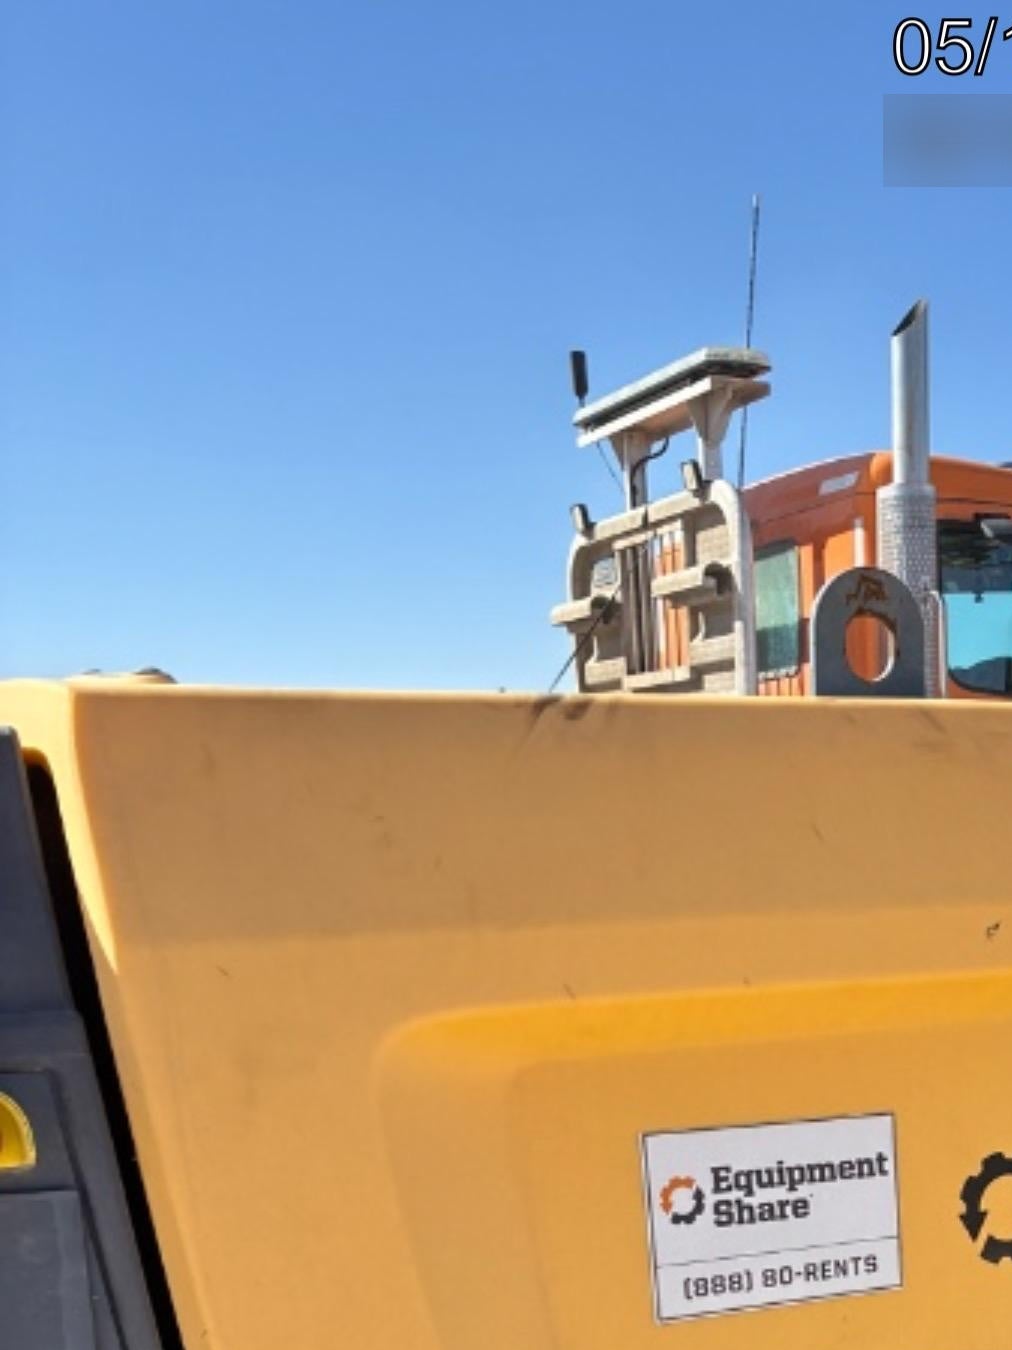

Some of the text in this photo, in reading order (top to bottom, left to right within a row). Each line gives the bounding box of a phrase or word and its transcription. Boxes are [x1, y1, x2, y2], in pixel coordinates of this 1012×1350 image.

[710, 1151, 888, 1197] Equipment
[713, 1196, 810, 1227] Share
[683, 1254, 878, 1300] (888) 80-RENTS
